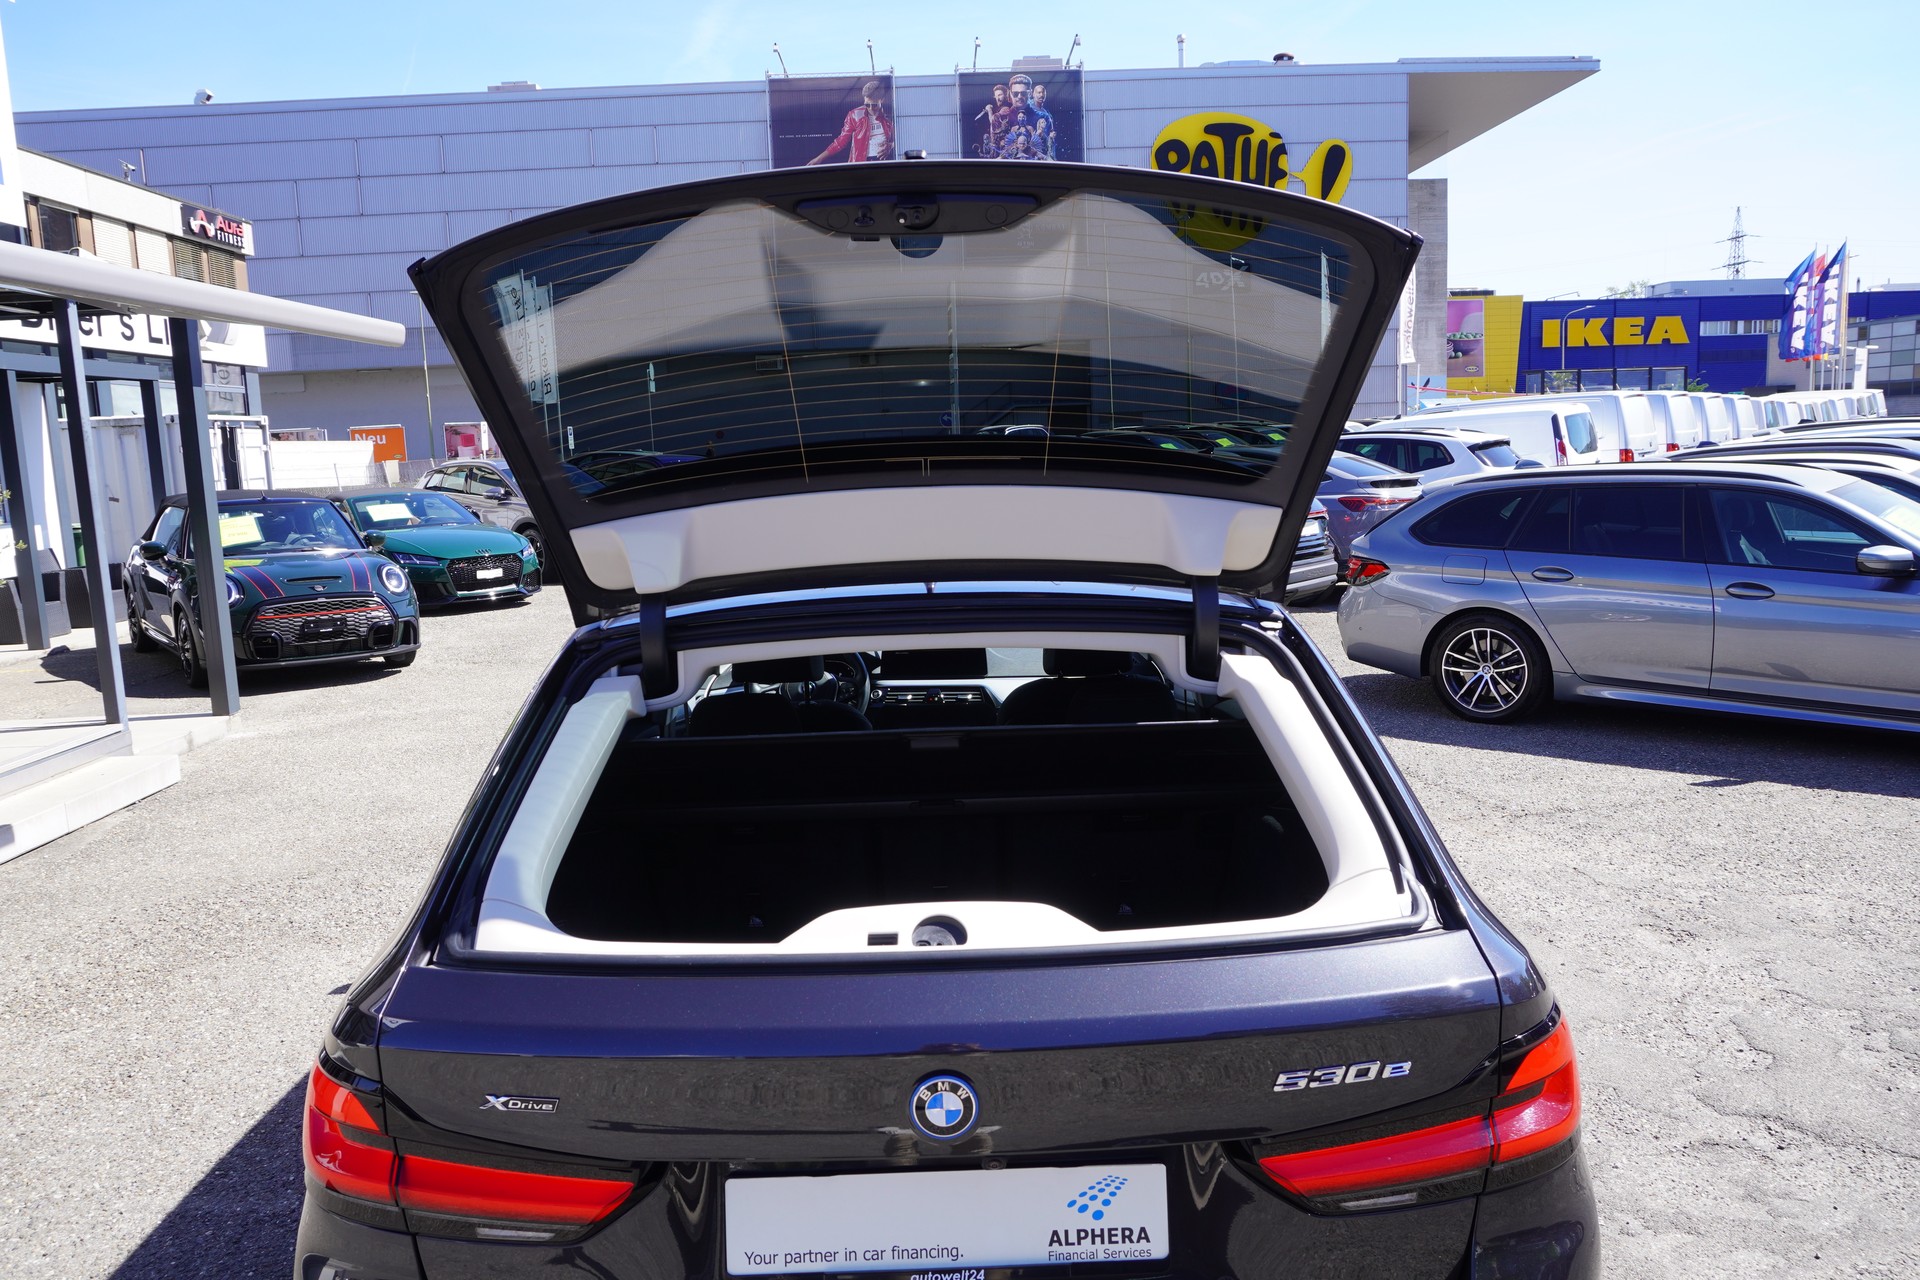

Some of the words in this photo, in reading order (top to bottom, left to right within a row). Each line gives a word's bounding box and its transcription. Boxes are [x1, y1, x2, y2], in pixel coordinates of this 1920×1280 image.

[216, 215, 244, 236] Aura
[1542, 316, 1690, 348] IKEA
[355, 433, 387, 445] Neu
[1273, 1060, 1412, 1092] 530e
[919, 1081, 969, 1101] BMW
[1048, 1226, 1151, 1247] ALPHERA
[744, 1251, 779, 1265] Your
[784, 1249, 839, 1267] partner
[844, 1247, 858, 1261] in
[863, 1248, 886, 1261] car
[891, 1244, 964, 1261] financing.
[1048, 1248, 1098, 1261] Financial
[1103, 1248, 1152, 1259] Services
